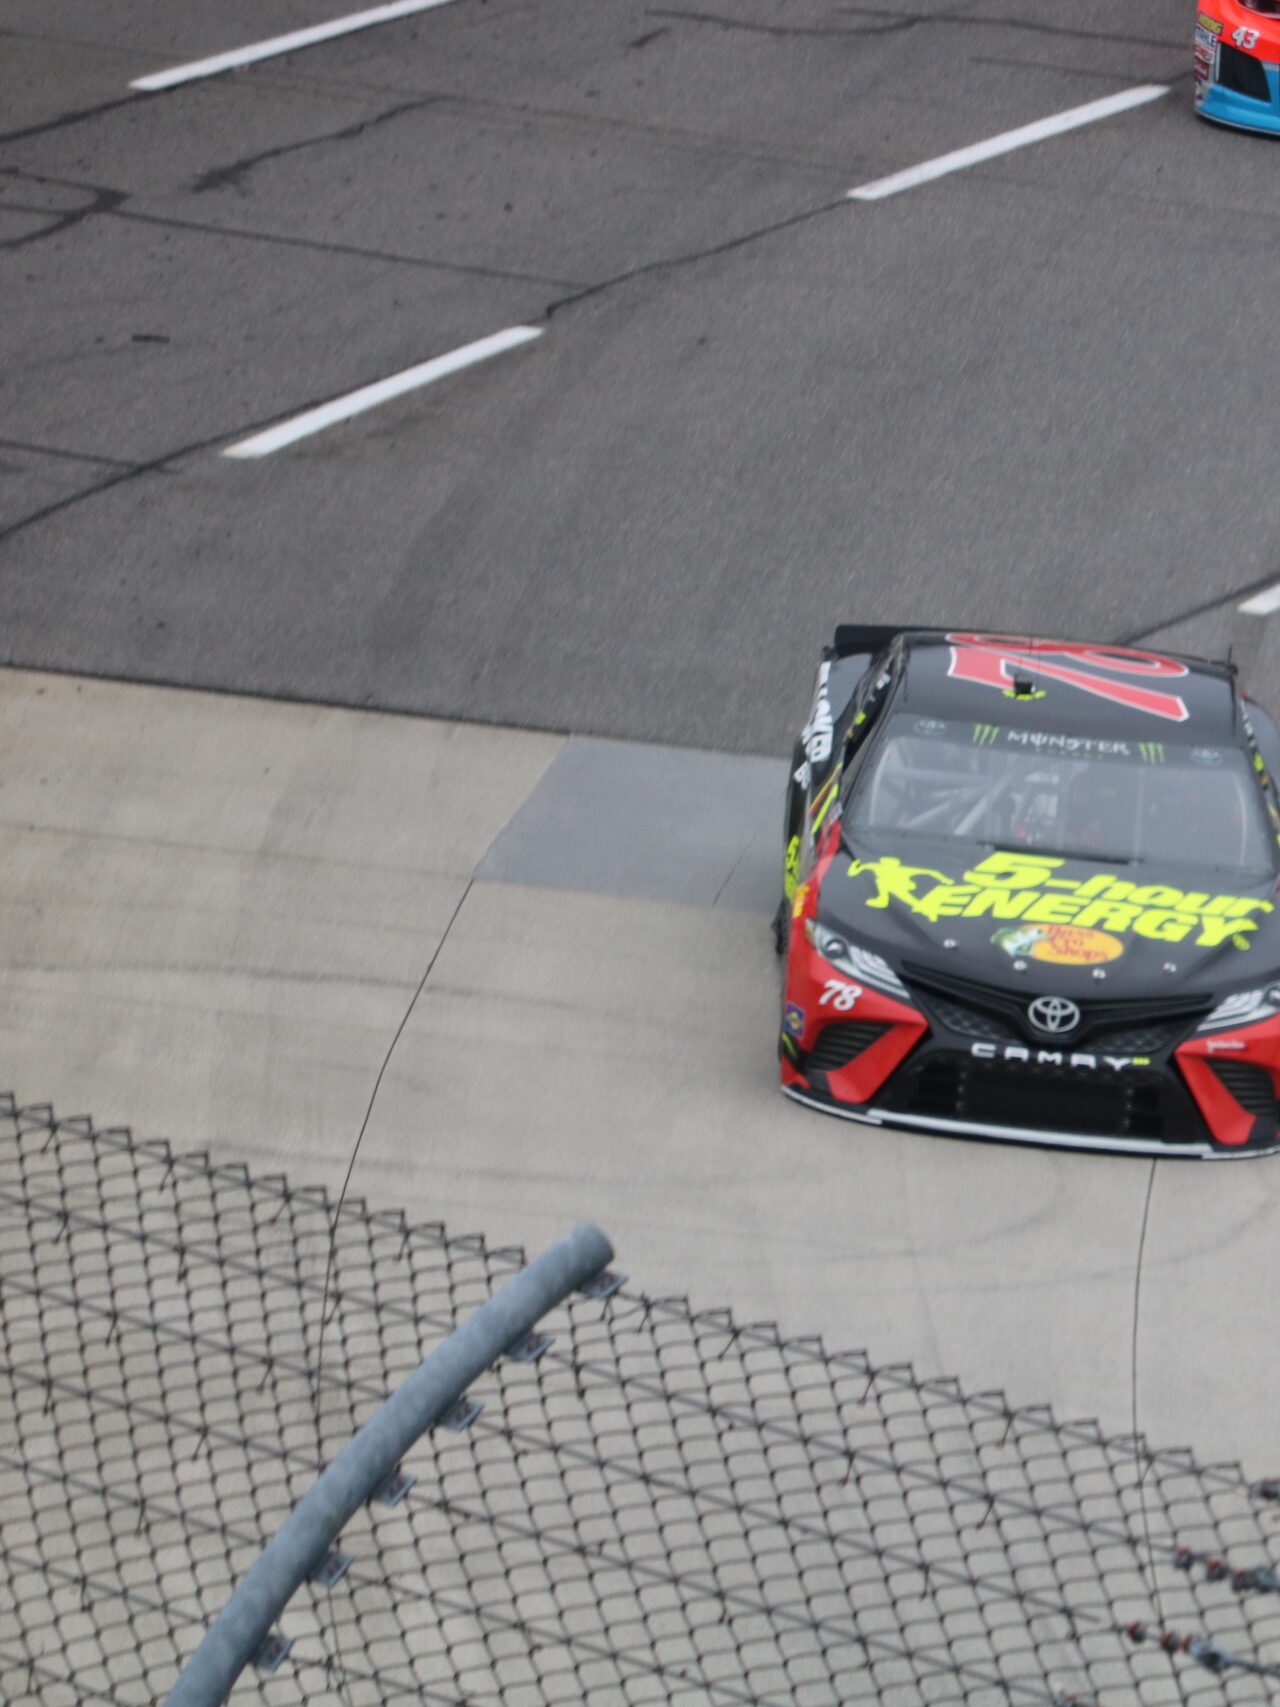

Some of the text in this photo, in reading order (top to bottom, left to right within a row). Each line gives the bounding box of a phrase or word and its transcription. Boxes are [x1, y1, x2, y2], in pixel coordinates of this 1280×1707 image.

[1232, 26, 1260, 49] 43
[1006, 729, 1131, 756] MONSTER
[963, 851, 1274, 918] 5-hour
[931, 885, 1259, 947] ENERGY
[818, 978, 863, 1011] 78
[971, 1043, 1130, 1072] CAMRY
